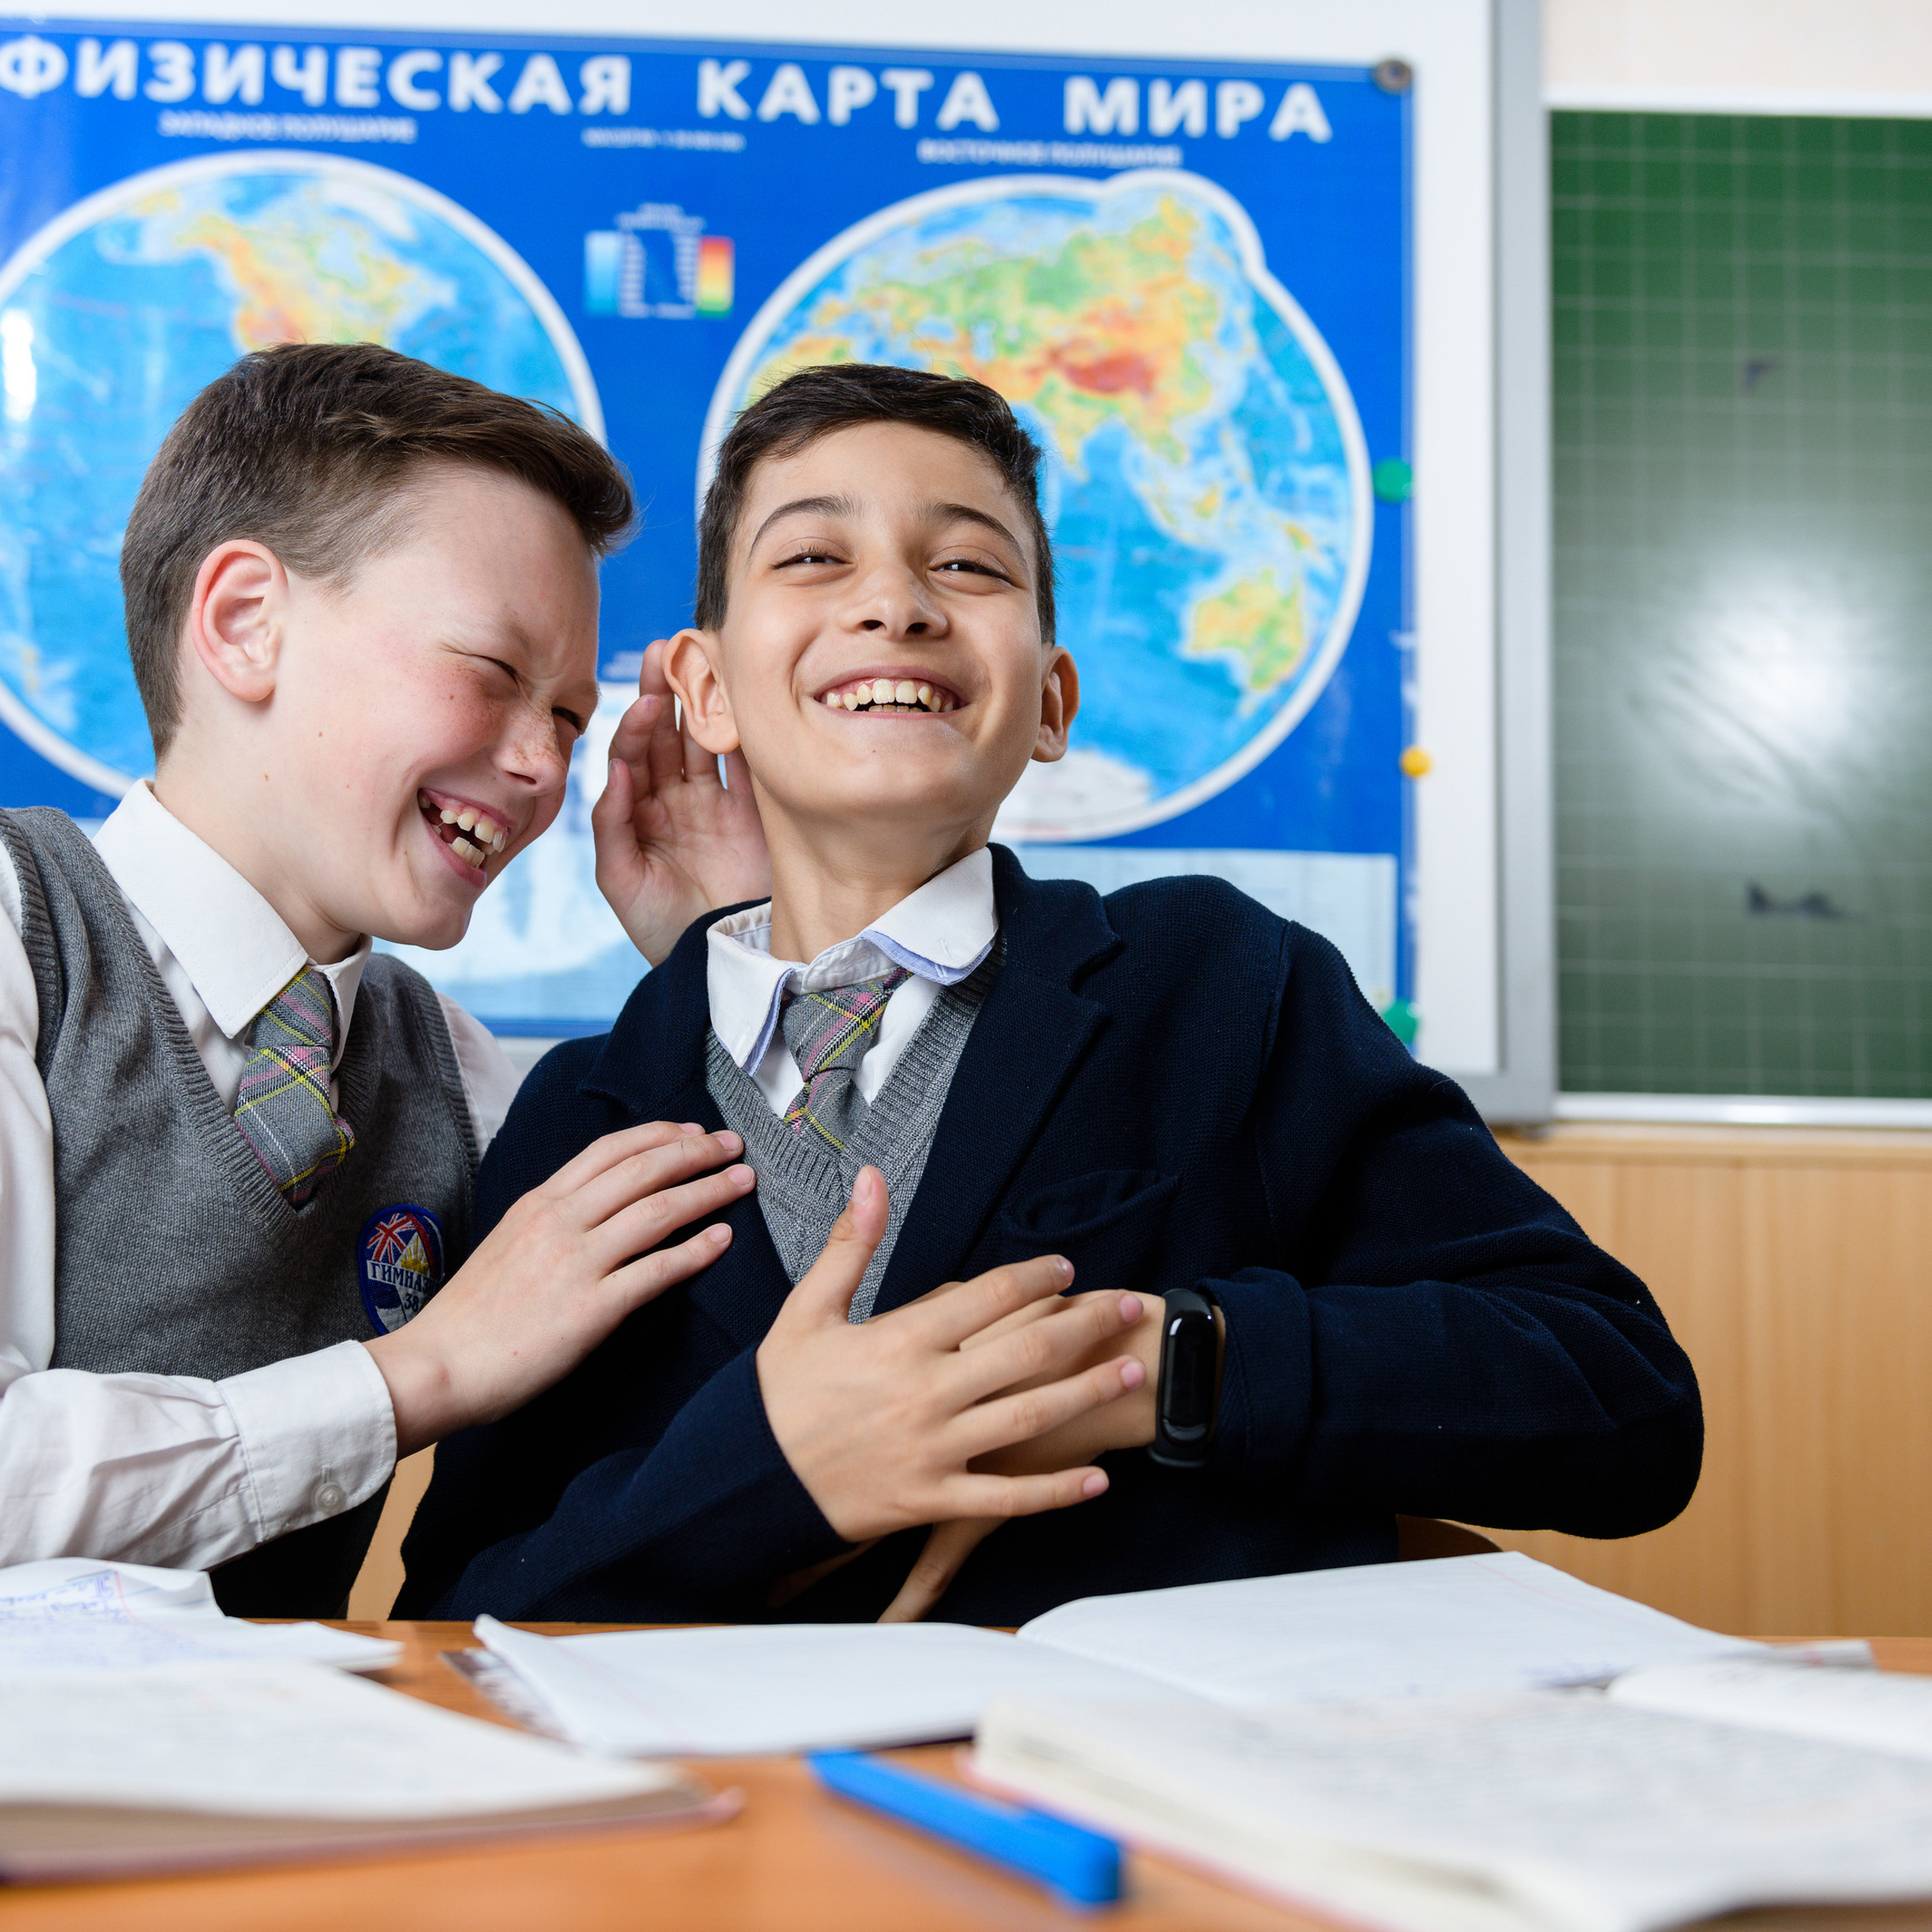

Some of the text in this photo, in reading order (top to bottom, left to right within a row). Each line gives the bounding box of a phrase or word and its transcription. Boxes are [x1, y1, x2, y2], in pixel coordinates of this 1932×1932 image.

[0, 33, 1333, 143] ФИЗИЧЕСКАЯ КАРТА МИРА
[405, 1293, 420, 1312] 38
